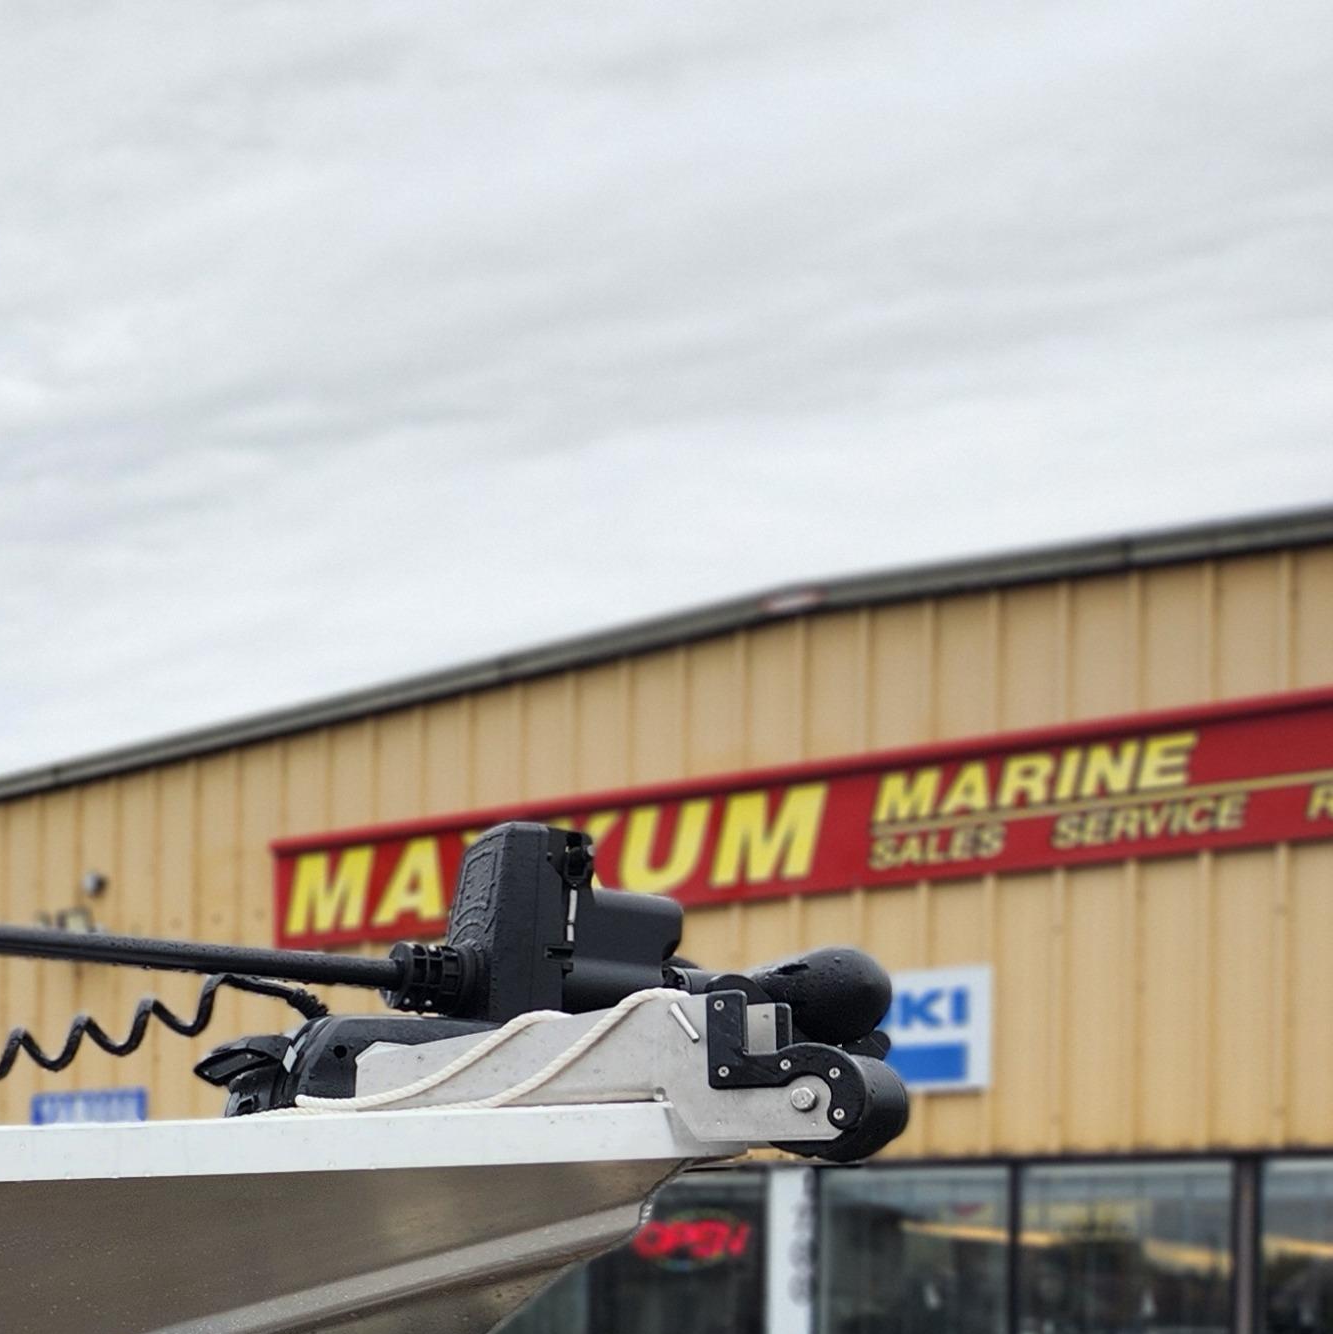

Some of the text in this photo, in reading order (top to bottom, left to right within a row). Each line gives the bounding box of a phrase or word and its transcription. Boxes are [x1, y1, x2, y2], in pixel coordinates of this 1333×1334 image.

[873, 731, 1198, 823] MARINE
[285, 782, 828, 936] MAUM
[869, 824, 1006, 870] SALES
[1051, 792, 1247, 849] SERVICE
[880, 986, 969, 1030] KI
